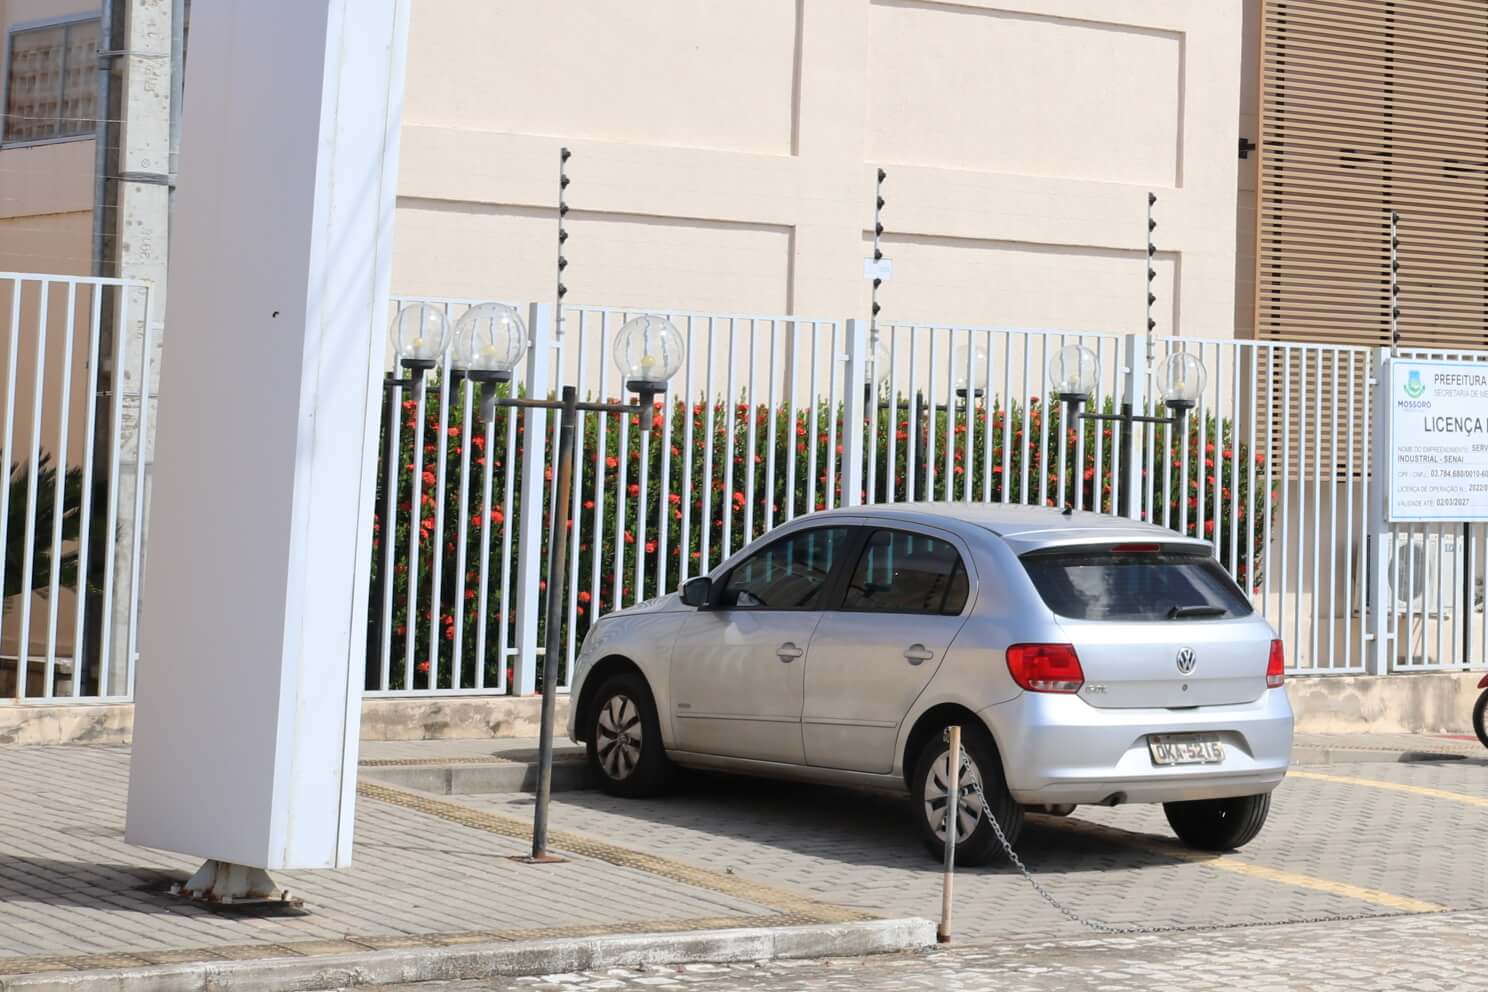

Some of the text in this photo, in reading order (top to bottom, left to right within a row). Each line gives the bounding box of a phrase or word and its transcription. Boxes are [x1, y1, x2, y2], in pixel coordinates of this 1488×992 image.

[1434, 373, 1487, 386] PREFEITURA
[1424, 416, 1483, 437] LICENÇA
[1397, 455, 1438, 463] INDUSTRIAL
[1444, 455, 1464, 464] SENAI
